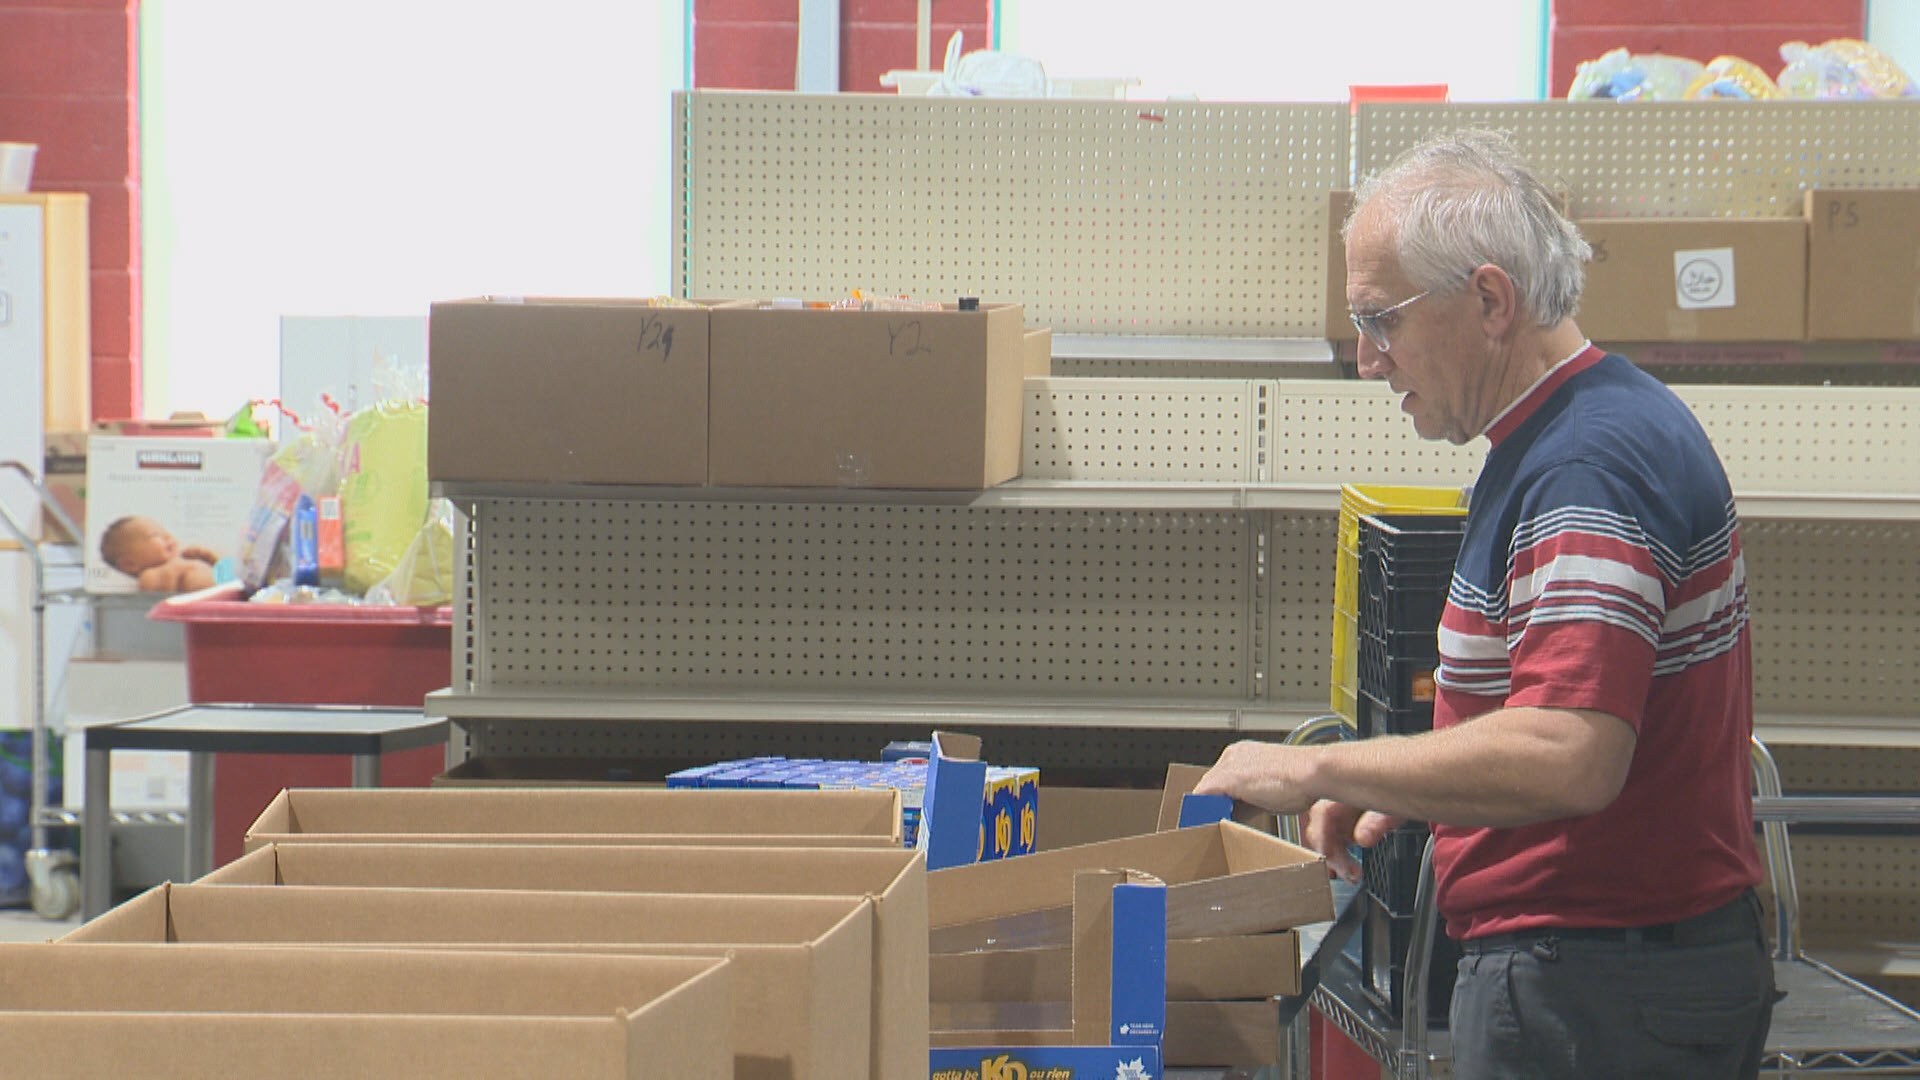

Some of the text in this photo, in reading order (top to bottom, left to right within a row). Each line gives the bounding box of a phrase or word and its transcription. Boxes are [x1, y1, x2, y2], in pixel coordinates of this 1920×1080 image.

[887, 319, 932, 356] Y2
[964, 1068, 979, 1080] be
[981, 1055, 1028, 1080] KD
[1029, 1070, 1045, 1079] ou
[1046, 1066, 1070, 1080] rien
